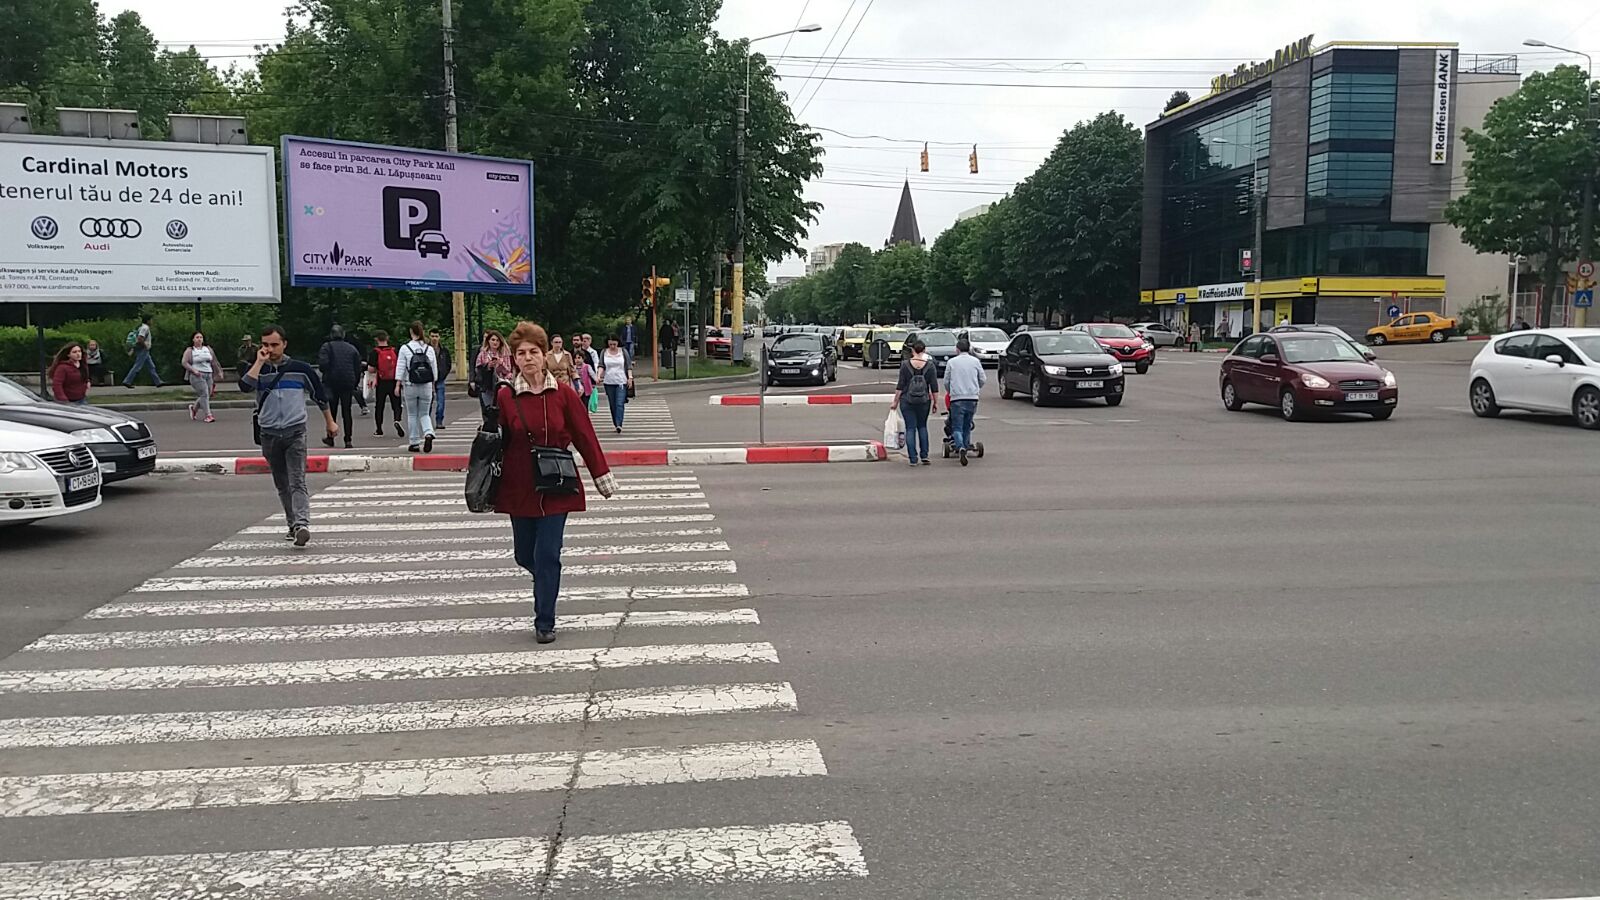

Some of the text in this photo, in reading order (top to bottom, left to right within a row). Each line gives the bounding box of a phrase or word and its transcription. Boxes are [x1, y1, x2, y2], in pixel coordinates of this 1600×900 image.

[22, 156, 189, 179] Cardinal Motors
[299, 148, 336, 160] Accesul
[350, 154, 391, 165] parcarea
[392, 157, 412, 168] City
[413, 159, 435, 169] Park
[436, 161, 455, 170] Mall
[300, 161, 310, 169] se
[312, 162, 332, 171] face
[334, 165, 354, 174] prin
[356, 166, 371, 175] Bd.
[374, 167, 386, 176] Al.
[0, 183, 243, 206] tenerul tău de 24 de ani!
[399, 198, 429, 239] P
[83, 243, 111, 251] Audi
[303, 253, 373, 267] CITY PARK
[174, 269, 205, 277] Showroom
